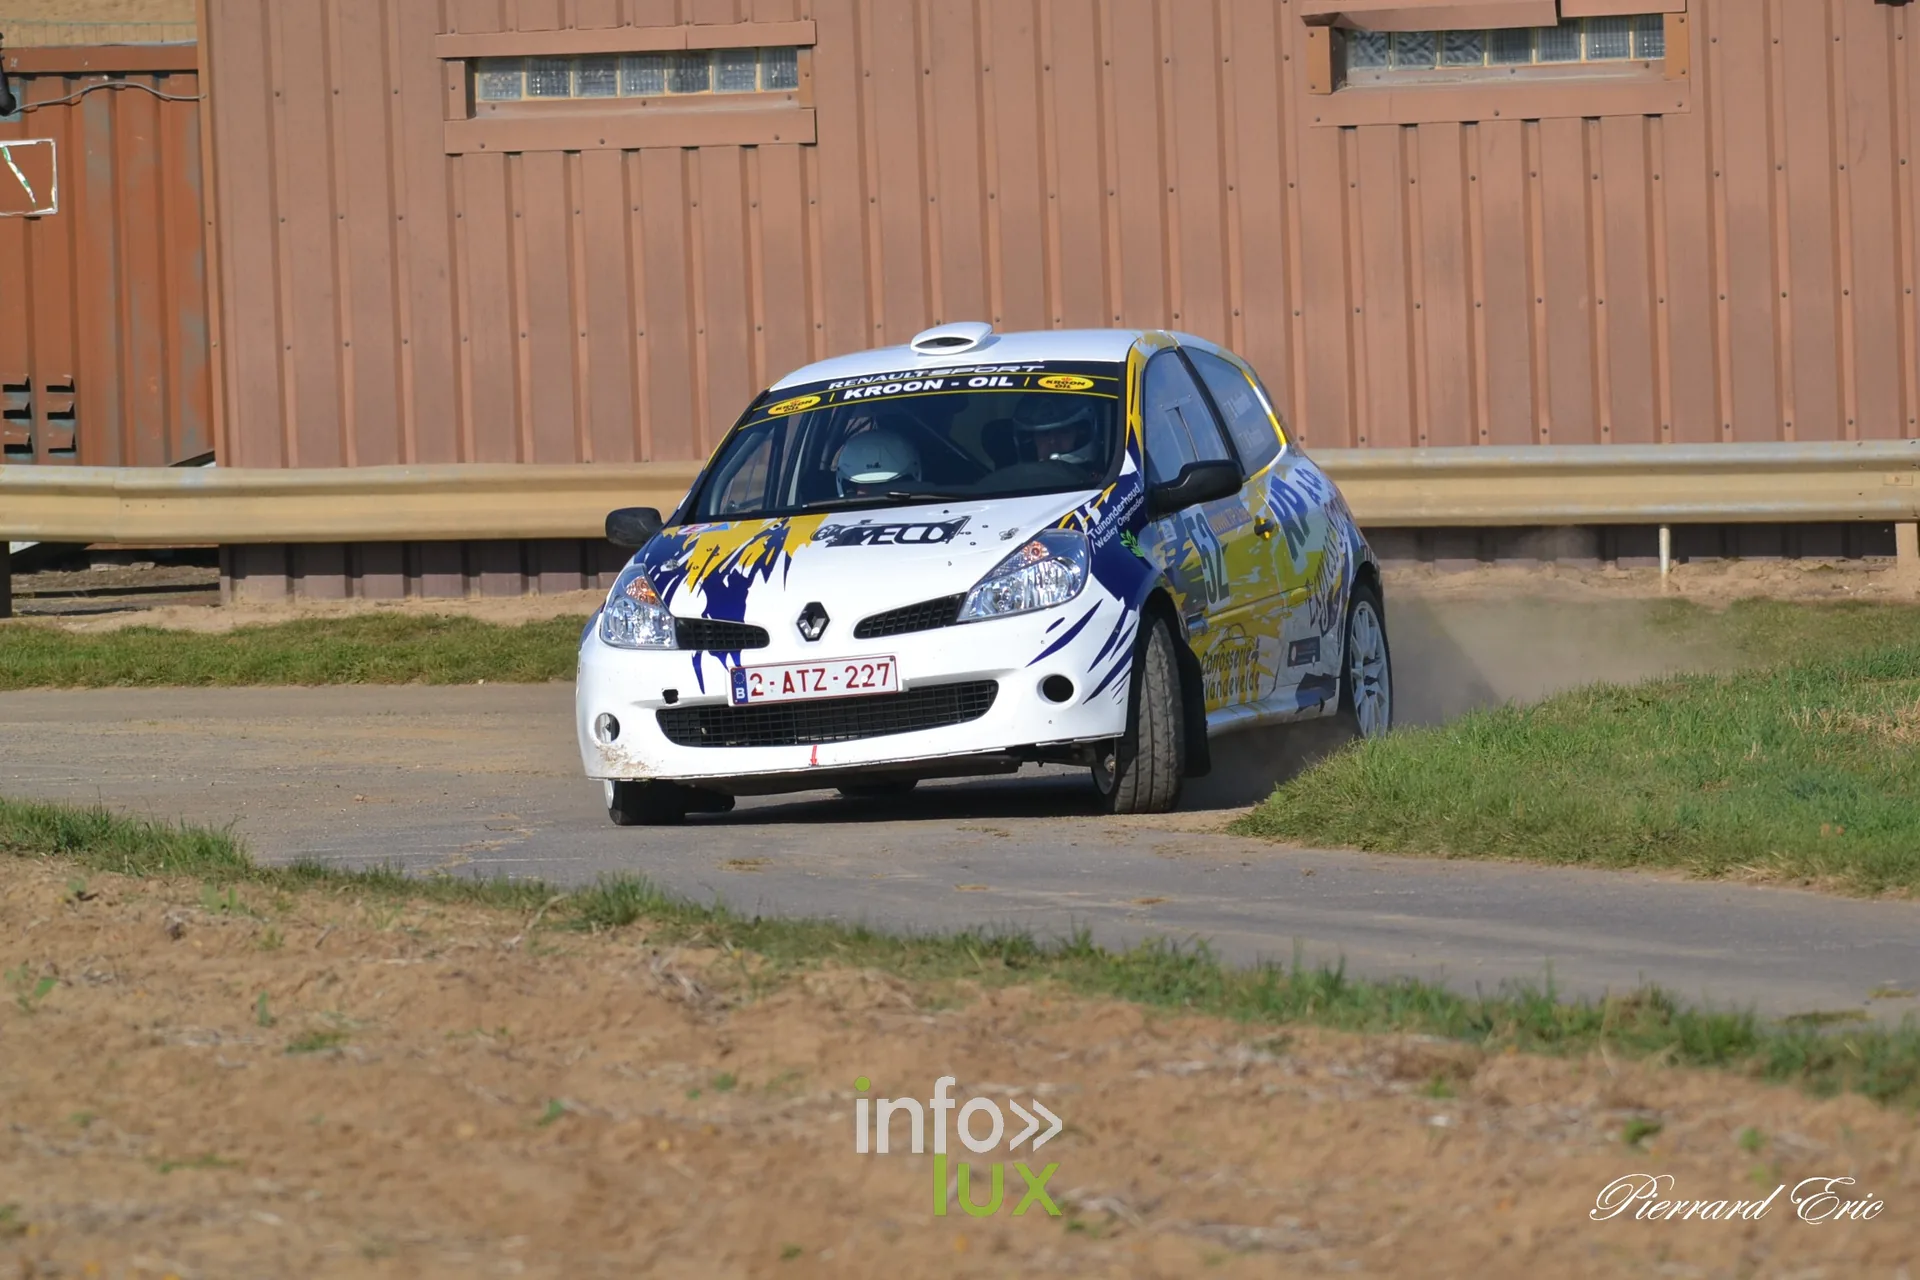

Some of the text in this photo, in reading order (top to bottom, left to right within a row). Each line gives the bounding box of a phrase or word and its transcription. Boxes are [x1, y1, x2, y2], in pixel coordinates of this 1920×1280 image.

[843, 378, 945, 401] KROON
[968, 376, 1014, 388] OIL
[1087, 482, 1141, 539] Tuinonderhoud
[1095, 525, 1119, 549] Wesley
[1183, 512, 1230, 605] 52
[735, 662, 890, 700] B 2-ATZ-227
